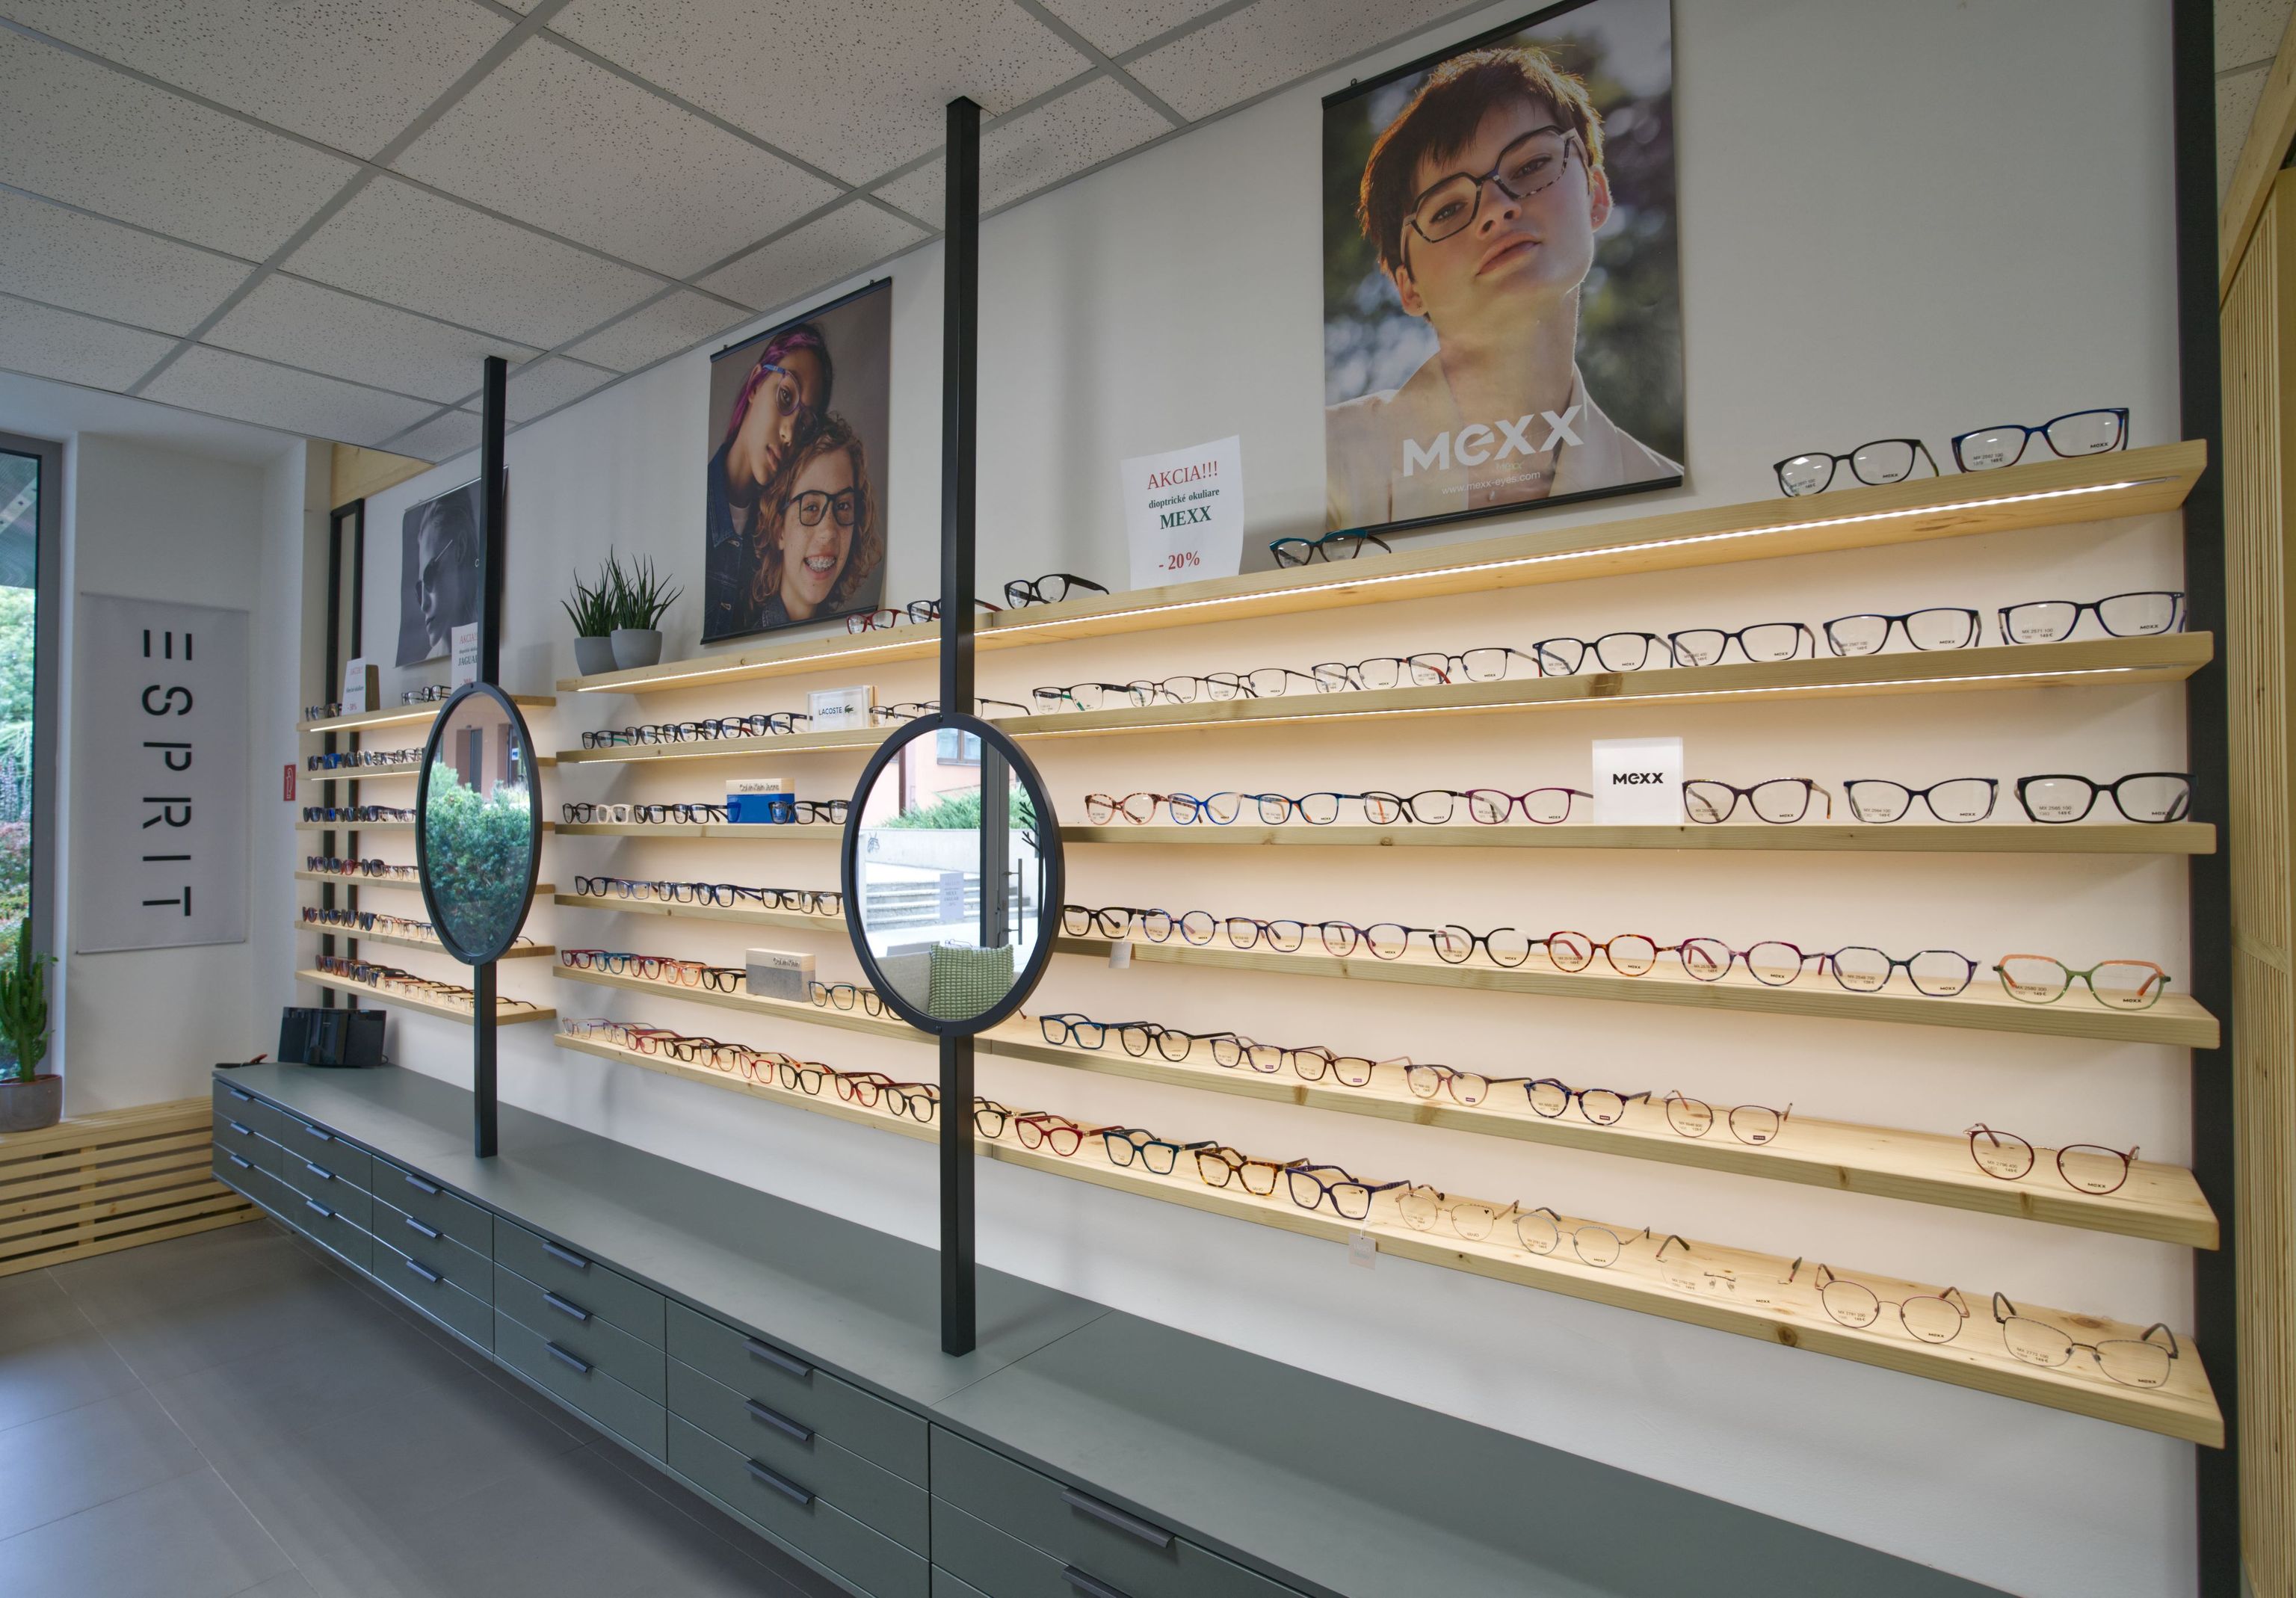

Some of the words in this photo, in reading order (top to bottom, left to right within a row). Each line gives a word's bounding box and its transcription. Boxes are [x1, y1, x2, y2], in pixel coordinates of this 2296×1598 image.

[1147, 460, 1218, 490] AKCIA!!!
[1441, 471, 1540, 496] www.mexx-eyes.com
[1148, 493, 1186, 509] dioptrické
[1188, 489, 1220, 501] okuliare
[1160, 505, 1212, 530] MEXX
[1168, 550, 1200, 570] 20%
[818, 706, 842, 715] LACOSTE
[141, 629, 193, 916] ESPRIT
